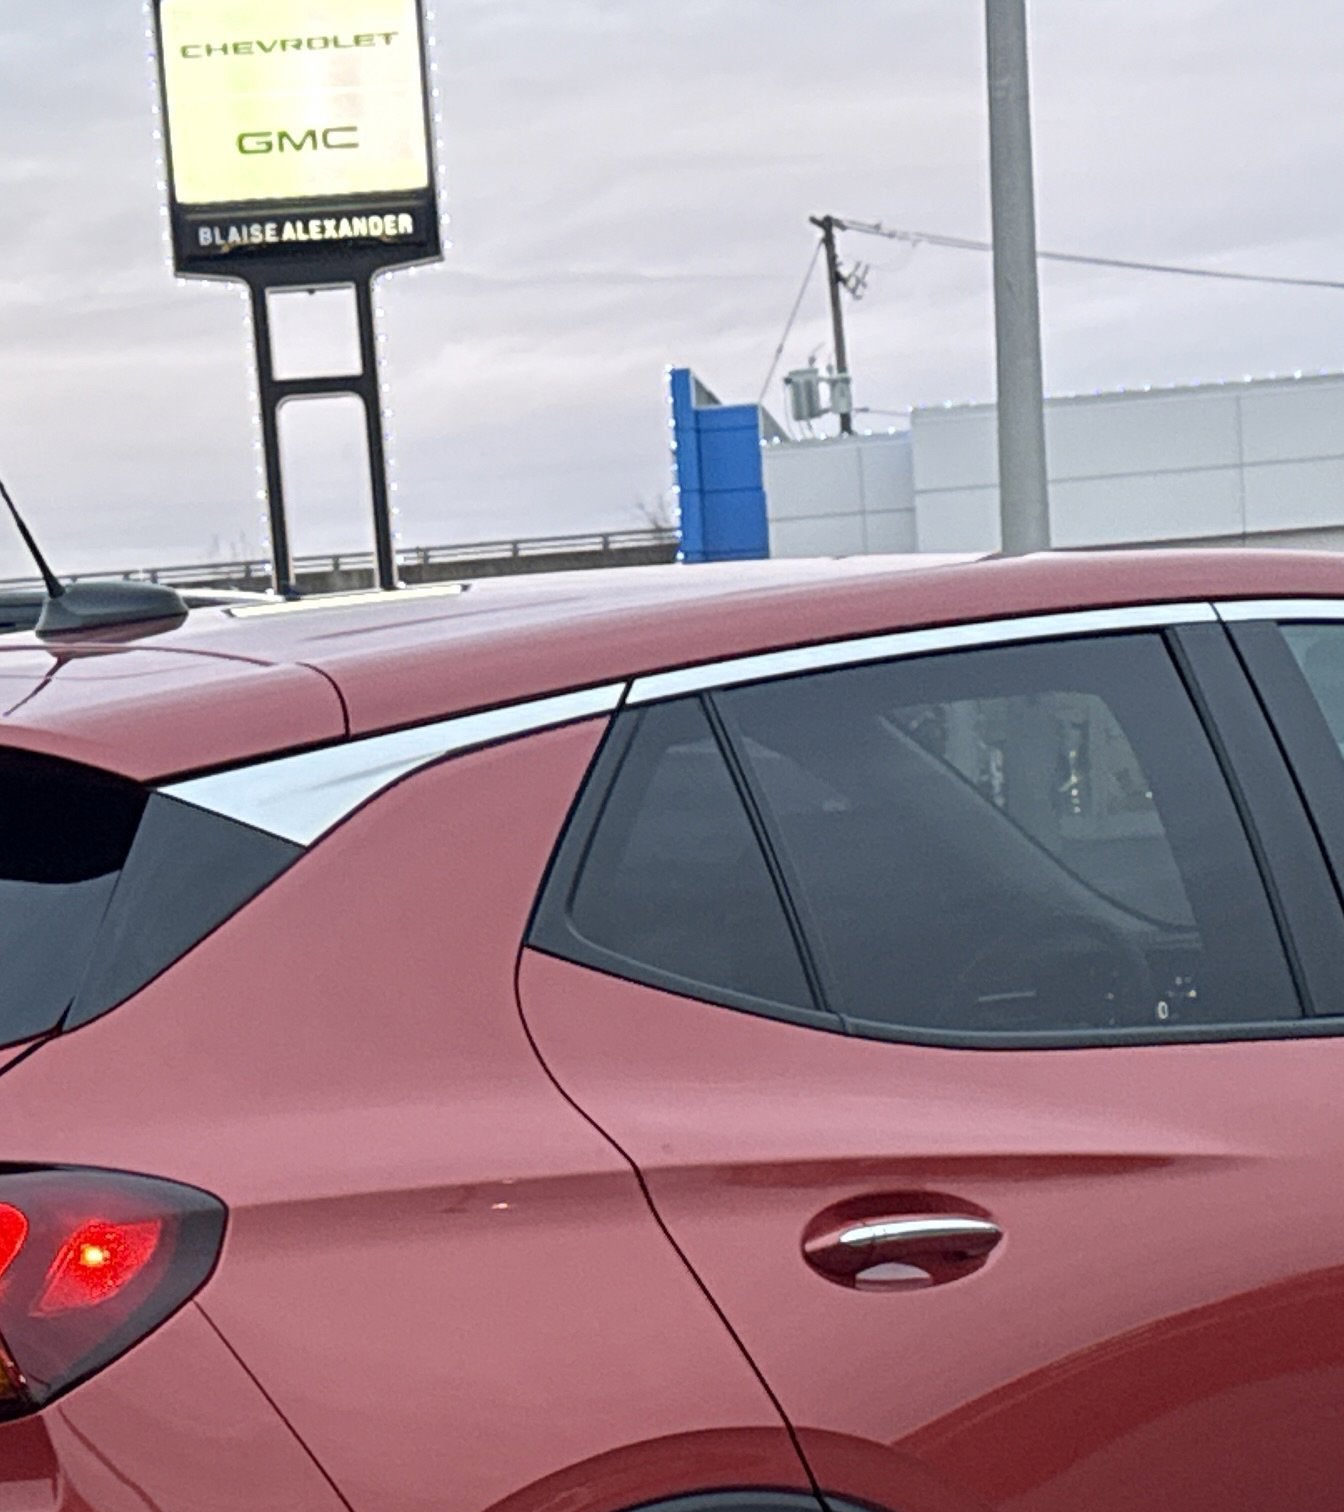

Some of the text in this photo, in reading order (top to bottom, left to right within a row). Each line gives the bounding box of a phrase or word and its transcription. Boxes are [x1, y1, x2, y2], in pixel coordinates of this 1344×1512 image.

[179, 31, 399, 59] CHEVROLET
[236, 126, 360, 155] GMC
[198, 213, 413, 247] BLAISE ALEXANDER
